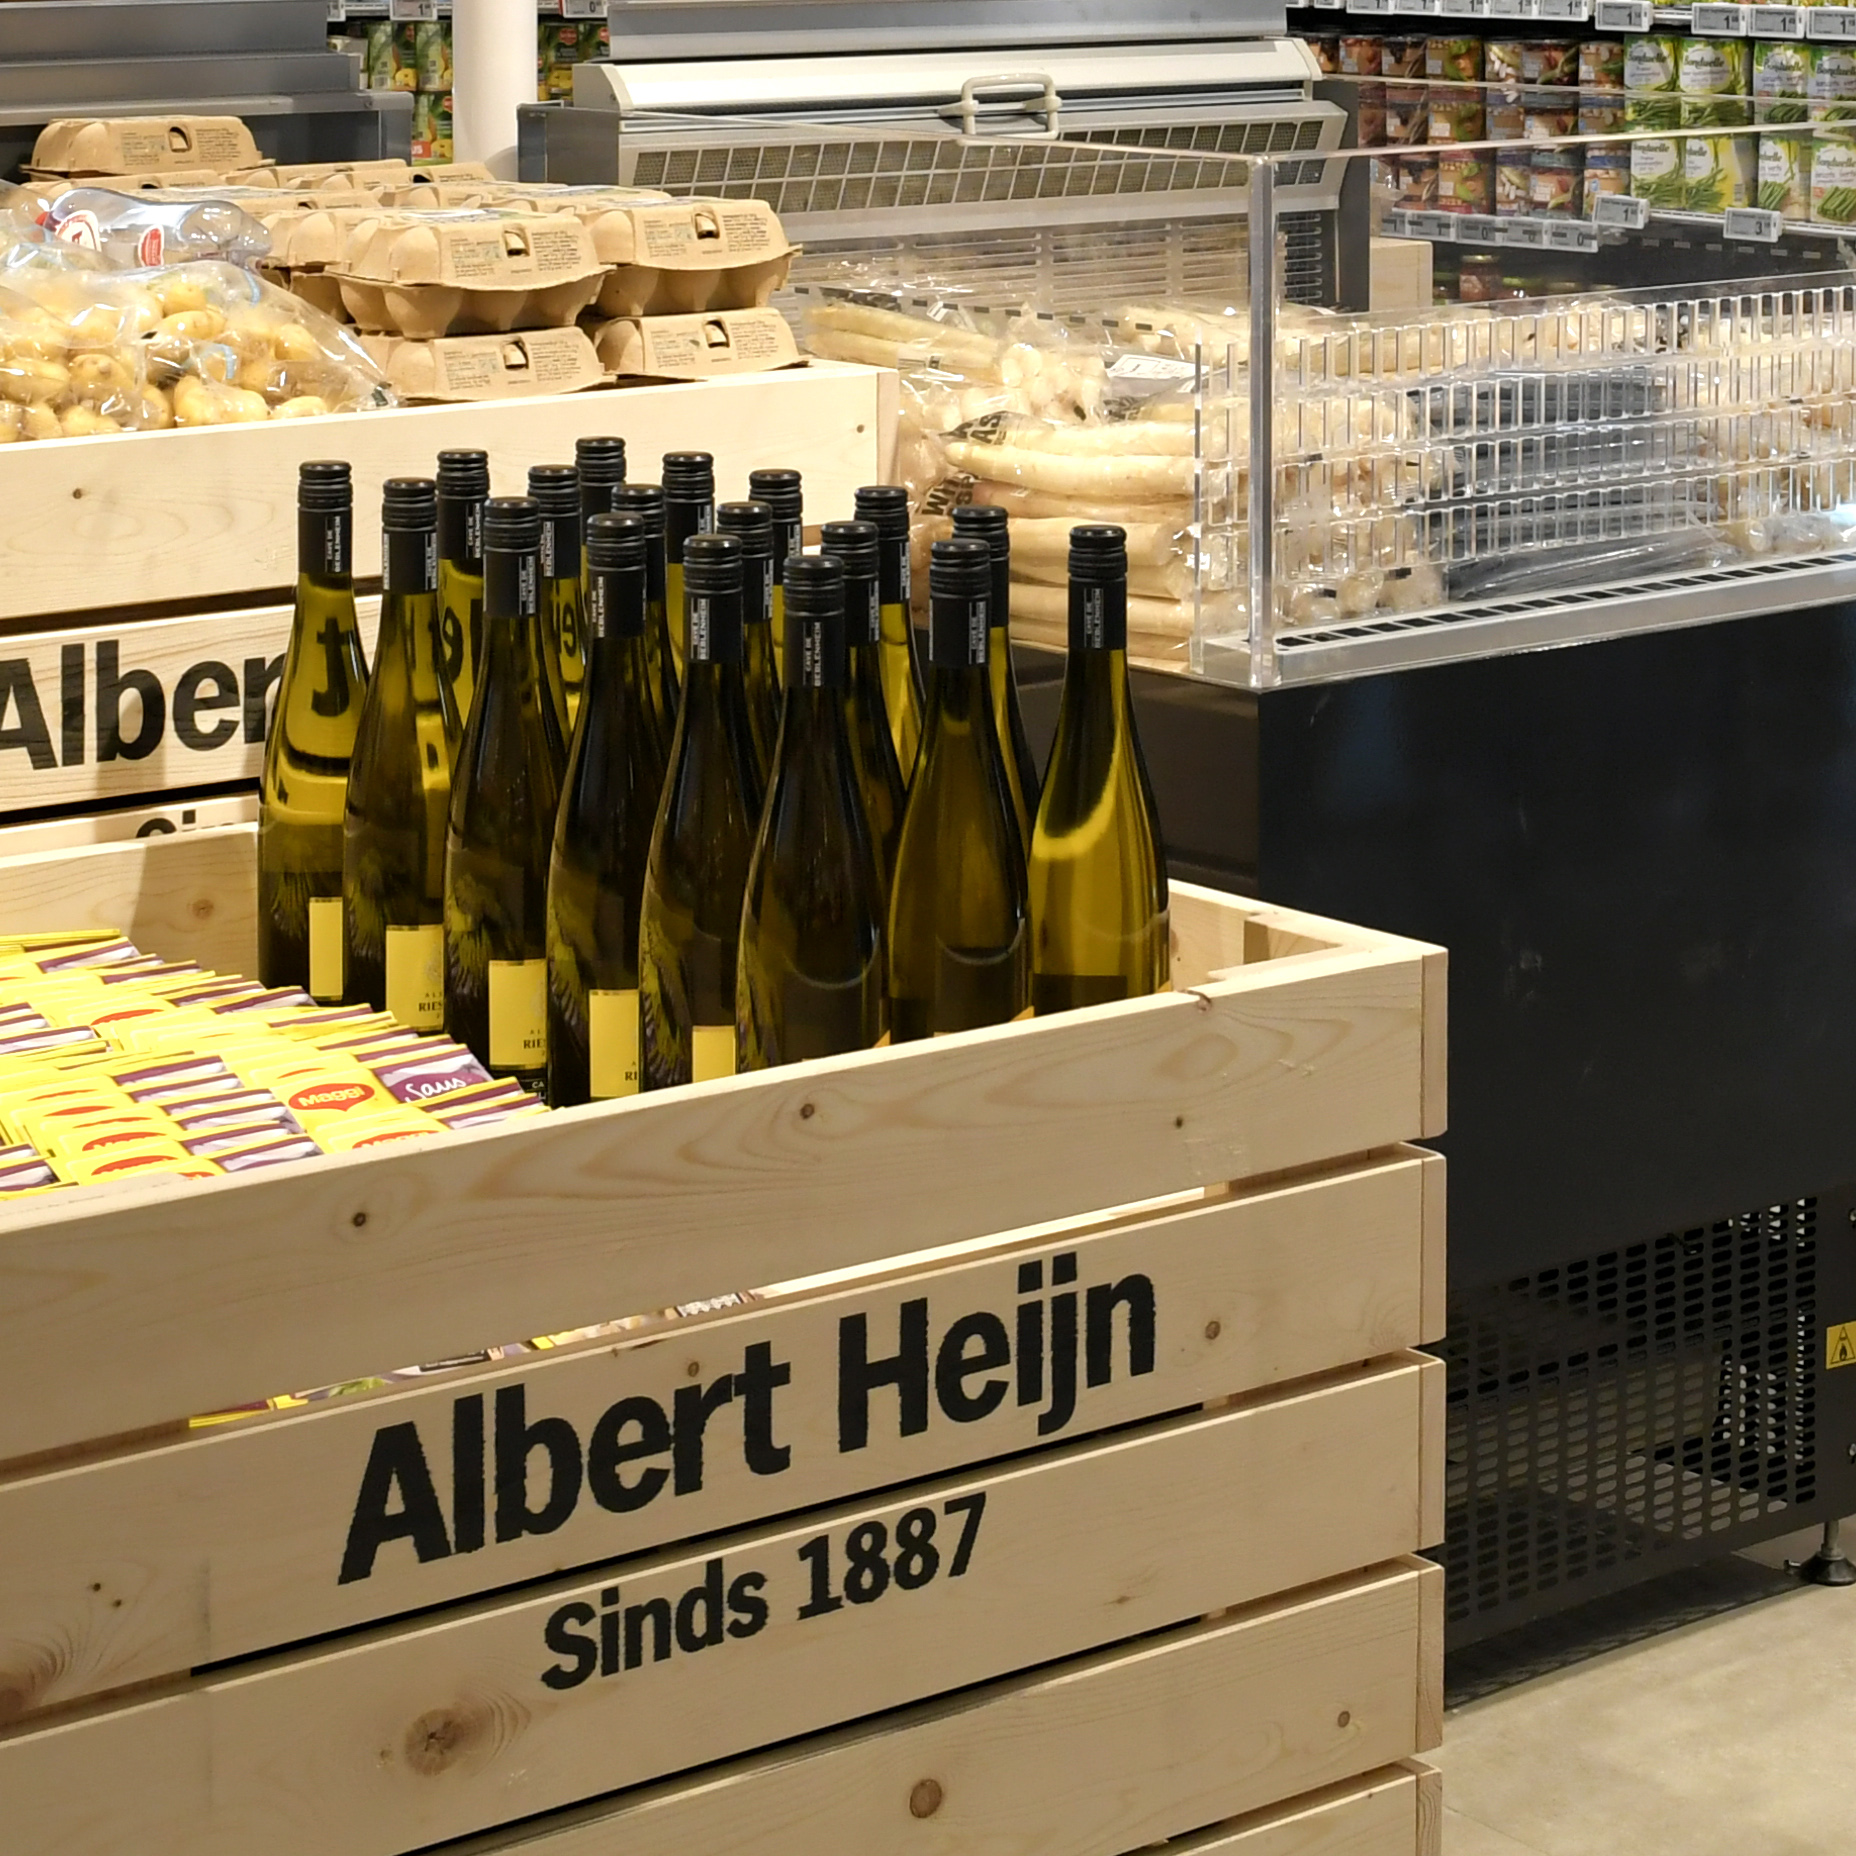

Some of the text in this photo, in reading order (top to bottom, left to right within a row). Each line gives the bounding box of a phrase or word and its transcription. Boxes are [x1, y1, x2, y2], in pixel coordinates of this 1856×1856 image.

[337, 1251, 1156, 1585] Albert Heijn
[541, 1491, 986, 1691] Sinds 1887
